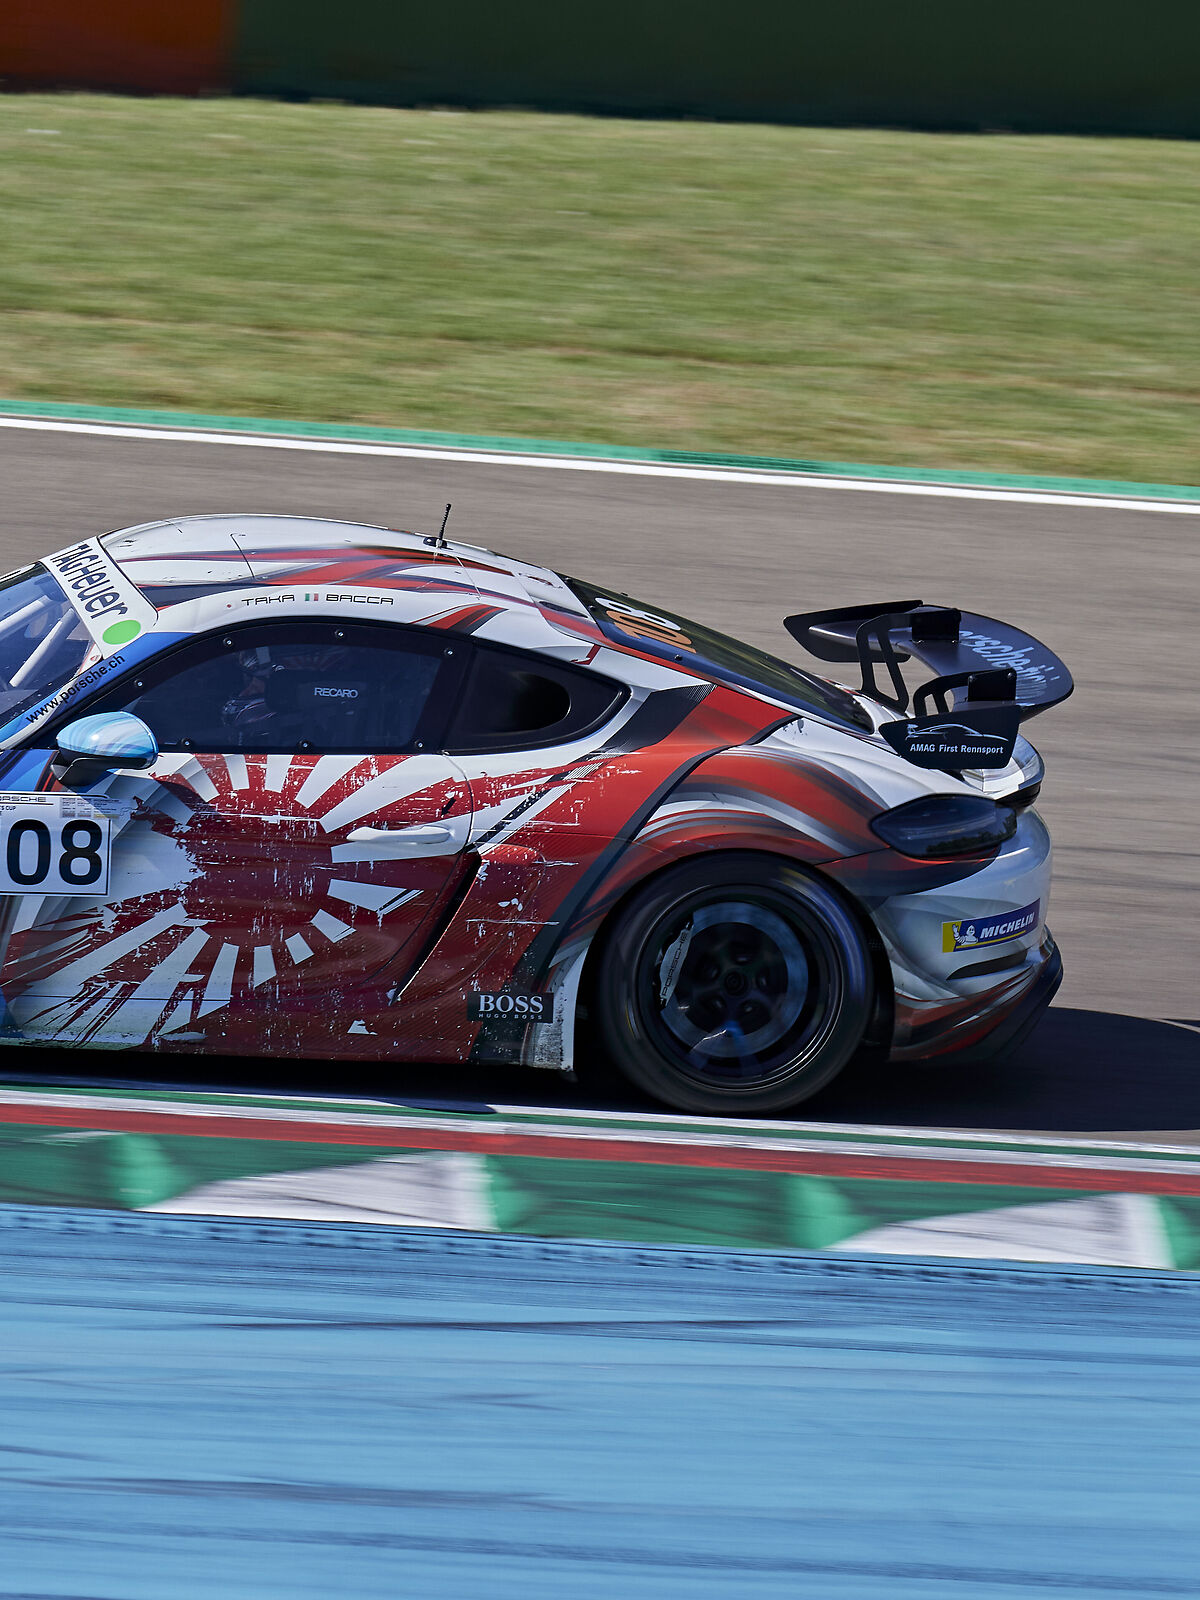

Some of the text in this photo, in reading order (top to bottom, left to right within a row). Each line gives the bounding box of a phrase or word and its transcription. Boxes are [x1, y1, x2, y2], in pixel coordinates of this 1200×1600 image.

[241, 593, 394, 606] TAKA BACCA
[595, 597, 697, 654] 108
[26, 654, 126, 724] www.porsche.ch
[314, 687, 359, 699] RECARO
[909, 743, 1004, 755] AMAG First Rennsport
[980, 911, 1035, 939] MICHELIN
[478, 994, 544, 1014] BOSS
